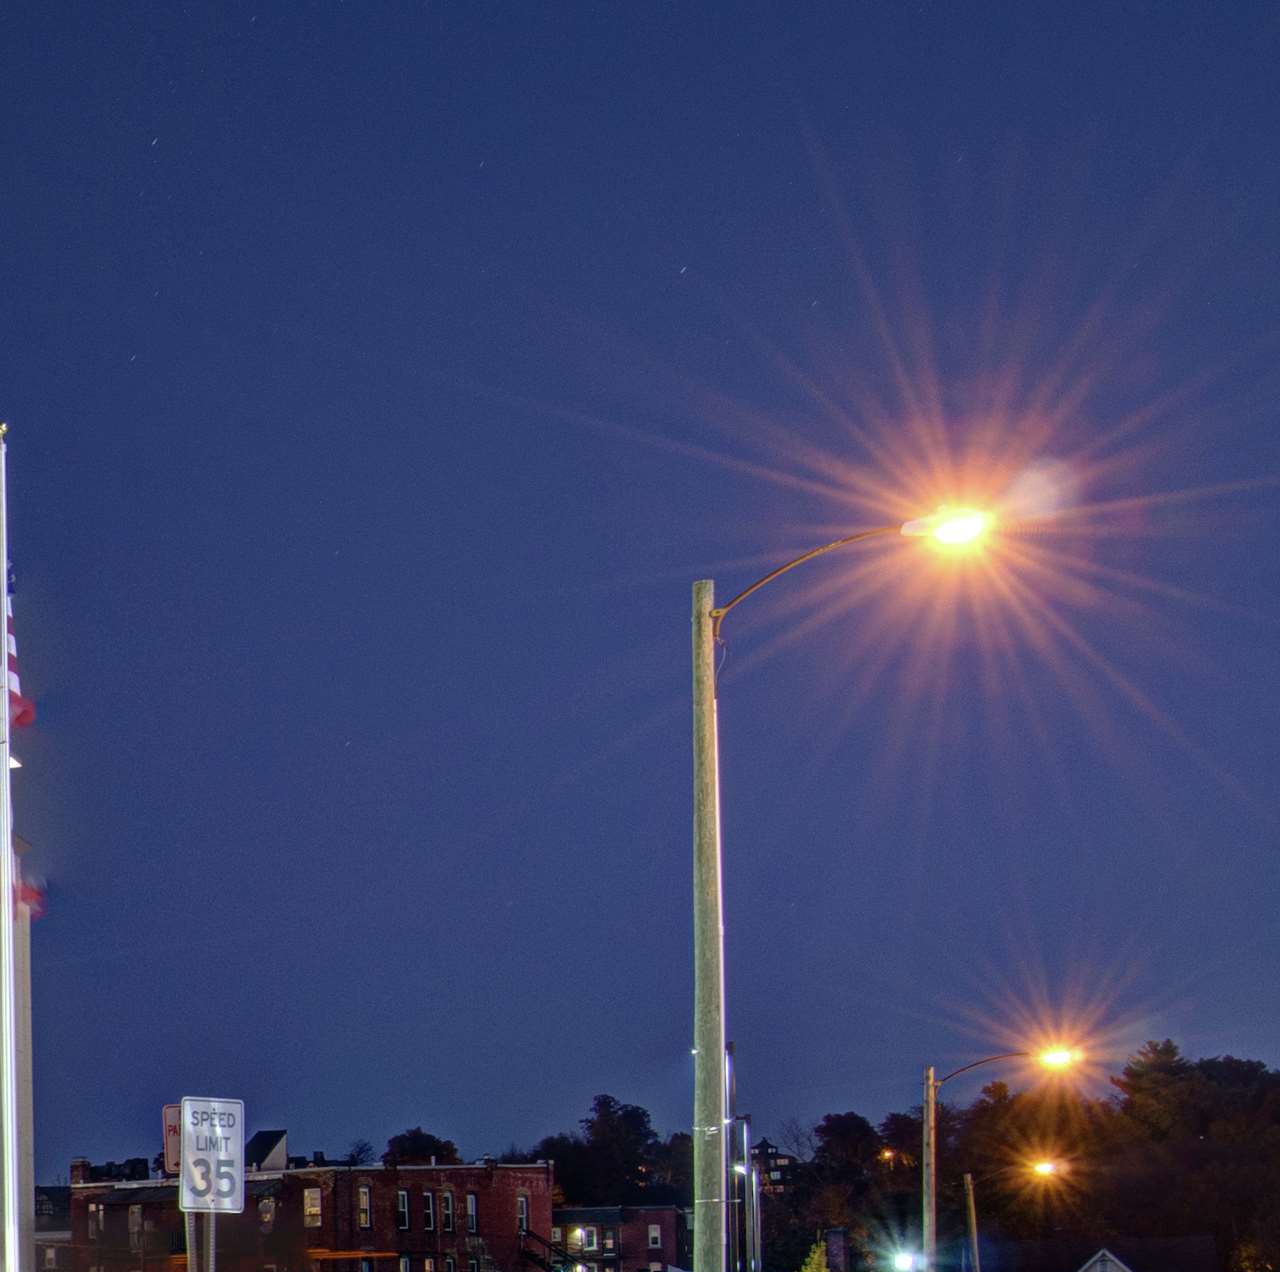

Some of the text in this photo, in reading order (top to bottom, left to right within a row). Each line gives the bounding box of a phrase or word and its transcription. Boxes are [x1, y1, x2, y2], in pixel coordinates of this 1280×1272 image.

[191, 1110, 237, 1129] SPEED
[196, 1136, 231, 1153] LIMIT
[190, 1158, 237, 1198] 35
